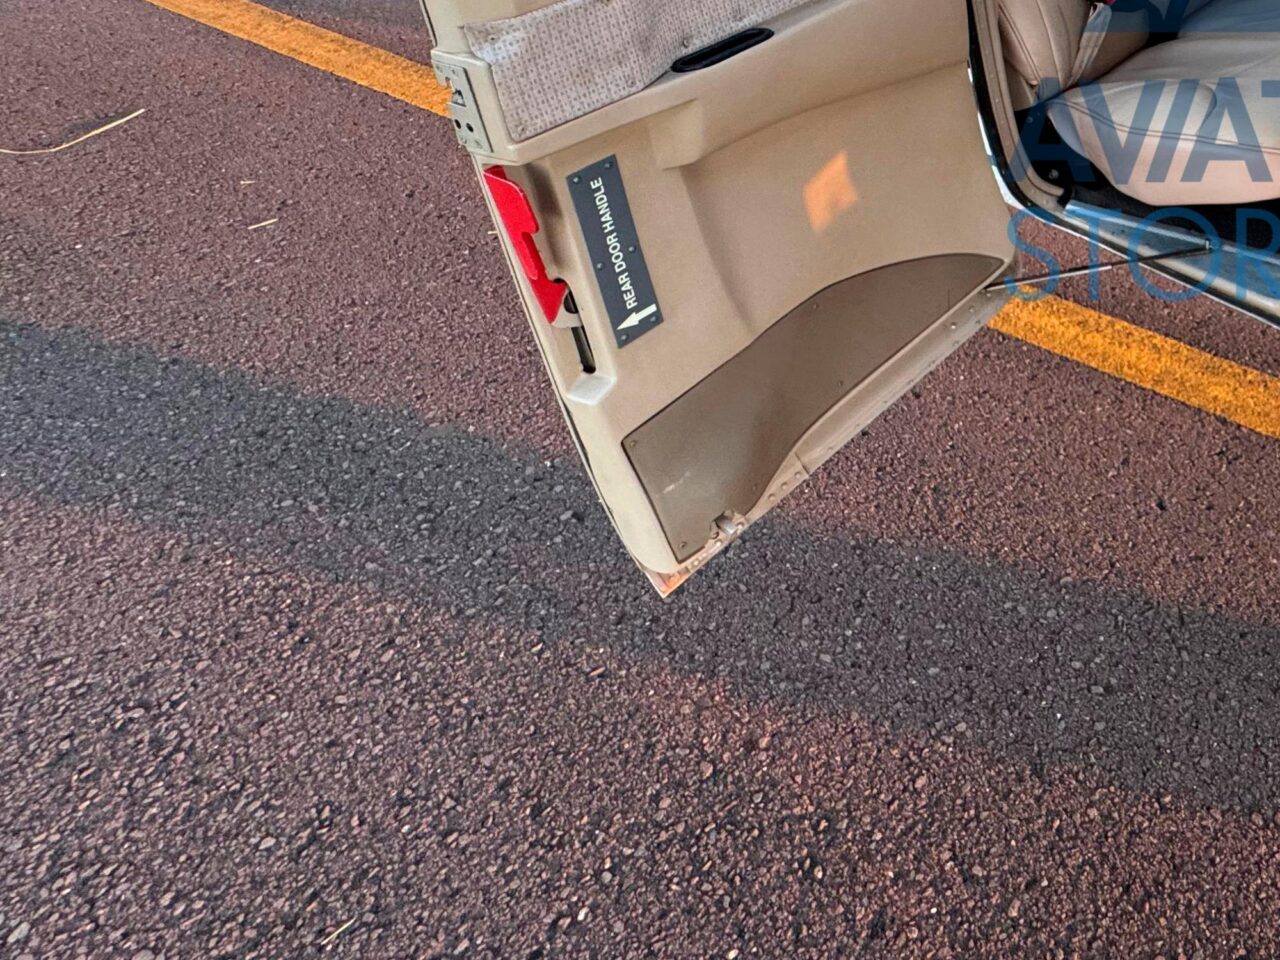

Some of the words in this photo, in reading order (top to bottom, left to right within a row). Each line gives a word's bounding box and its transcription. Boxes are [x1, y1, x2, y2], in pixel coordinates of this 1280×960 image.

[589, 176, 615, 233] HANDLE
[606, 232, 627, 273] DOOR
[618, 271, 638, 309] REAR
